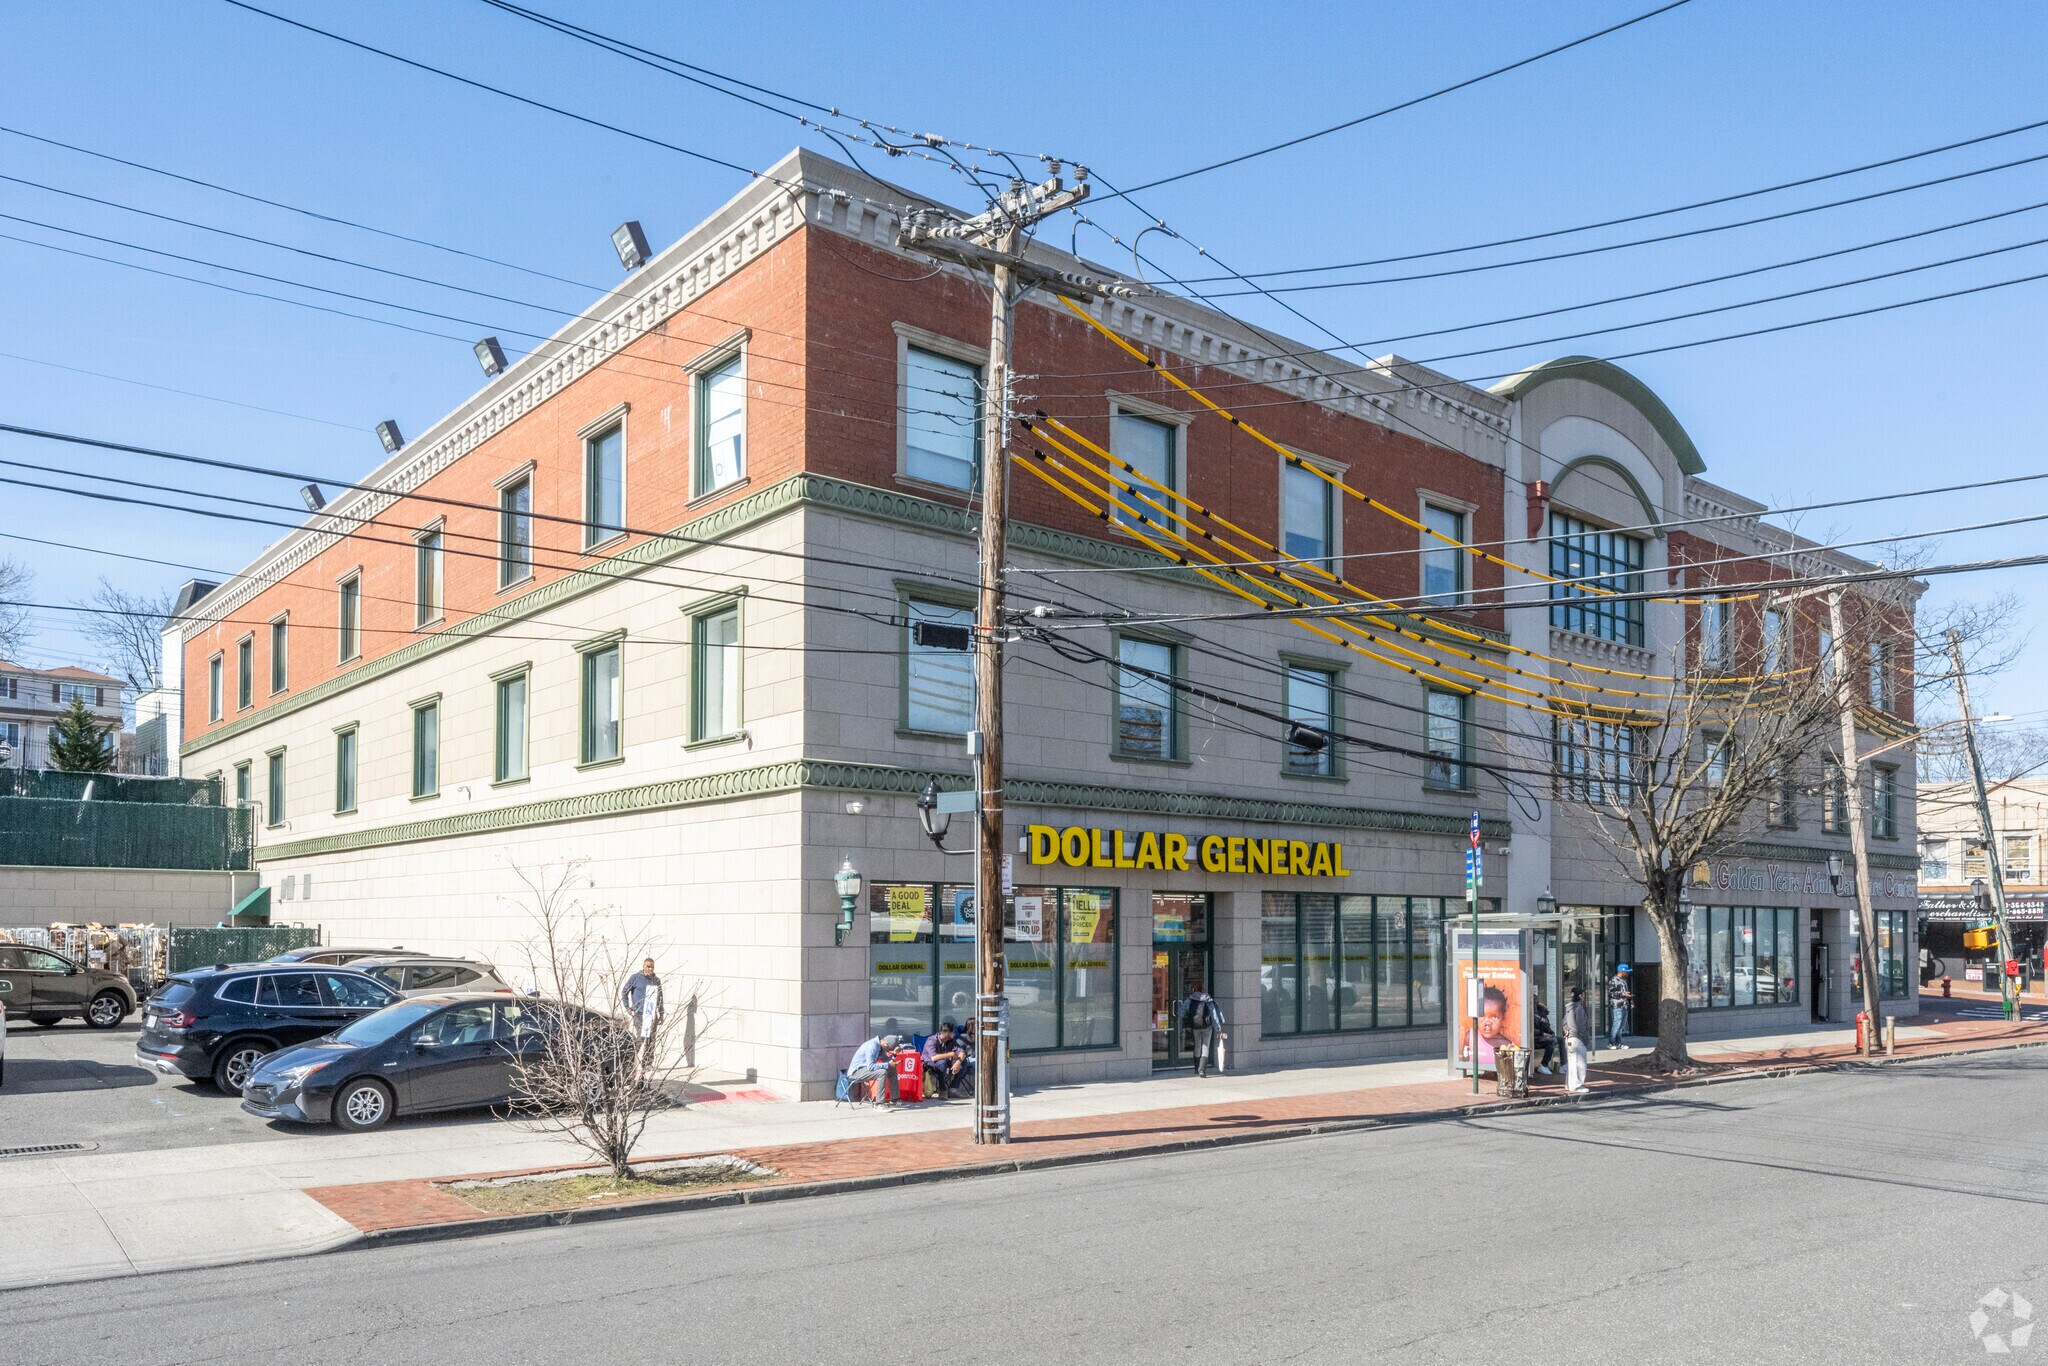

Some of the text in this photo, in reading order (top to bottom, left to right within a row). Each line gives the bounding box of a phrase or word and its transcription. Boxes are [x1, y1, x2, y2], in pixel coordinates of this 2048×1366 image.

[1028, 824, 1350, 877] DOLLAR GENERAL
[1716, 859, 1765, 891] Golden
[1767, 864, 1800, 893] Years
[1883, 871, 1916, 898] Center
[891, 891, 920, 900] A GOOD
[891, 901, 911, 910] DEAL
[1462, 970, 1516, 979] Forver Smiles
